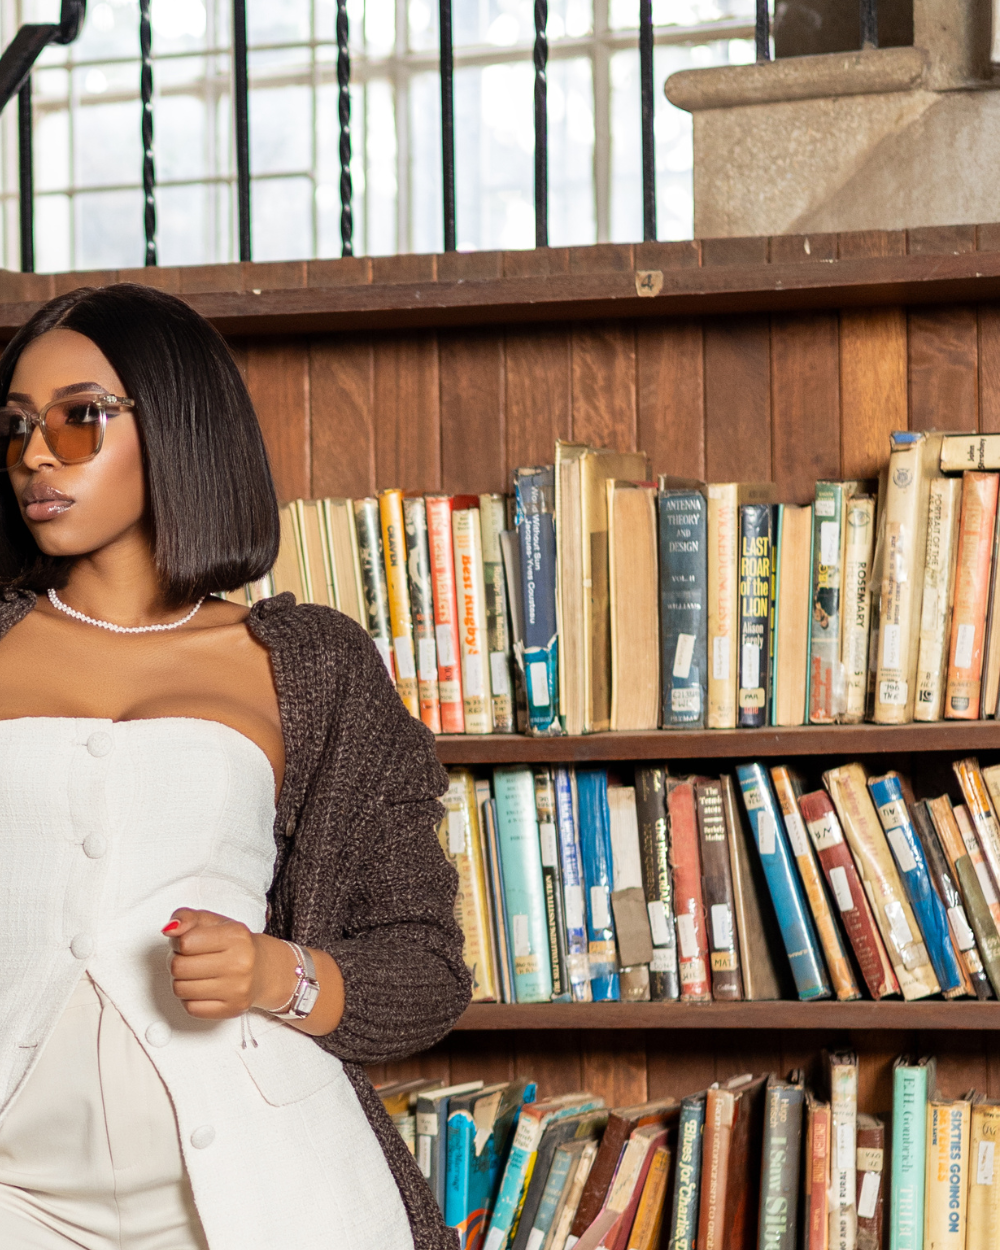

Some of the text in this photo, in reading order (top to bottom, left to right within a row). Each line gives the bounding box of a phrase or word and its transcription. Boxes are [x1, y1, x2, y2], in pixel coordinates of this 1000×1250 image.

[665, 499, 701, 511] ANTENNA
[667, 513, 700, 526] THEORY
[386, 525, 398, 567] CRAVEN
[532, 514, 541, 570] Without Sun
[669, 541, 699, 552] DESIGN
[677, 529, 691, 538] AND
[743, 537, 769, 557] LAST
[931, 494, 942, 567] PORTRAIT OF THE
[433, 535, 449, 570] Team
[716, 506, 730, 620] WICKED UNCLES
[741, 557, 770, 577] ROAR
[494, 565, 503, 594] Rugby:
[525, 519, 536, 624] Jacques-Yves Cousteau
[740, 577, 768, 598] of the
[436, 573, 452, 621] Makers
[462, 555, 479, 646] Best Rugby
[666, 603, 701, 611] WILLIAMS
[742, 597, 768, 617] LION
[855, 562, 867, 628] ROSEMARY
[496, 616, 505, 650] Matches
[742, 622, 764, 634] Alison
[704, 787, 719, 796] The
[461, 855, 476, 916] DURSCHM
[645, 854, 656, 887] QUEEN
[468, 926, 480, 956] ERIK
[546, 875, 561, 993] THE SELF EVALUATING INSTITUTION
[768, 1091, 780, 1128] Portisch
[778, 1098, 789, 1122] Hugo
[679, 1120, 698, 1185] Blues for
[813, 1123, 826, 1184] ANCIENT CHINA
[901, 1110, 917, 1173] Gombrich
[937, 1109, 950, 1182] SEVENTIES
[709, 1132, 721, 1204] ottomanism
[769, 1136, 787, 1191] I Saw
[949, 1110, 963, 1233] SIXTIES GOING ON
[839, 1171, 848, 1198] RURAL
[708, 1205, 717, 1220] to
[812, 1207, 821, 1231] Walker
[839, 1220, 847, 1238] AND
